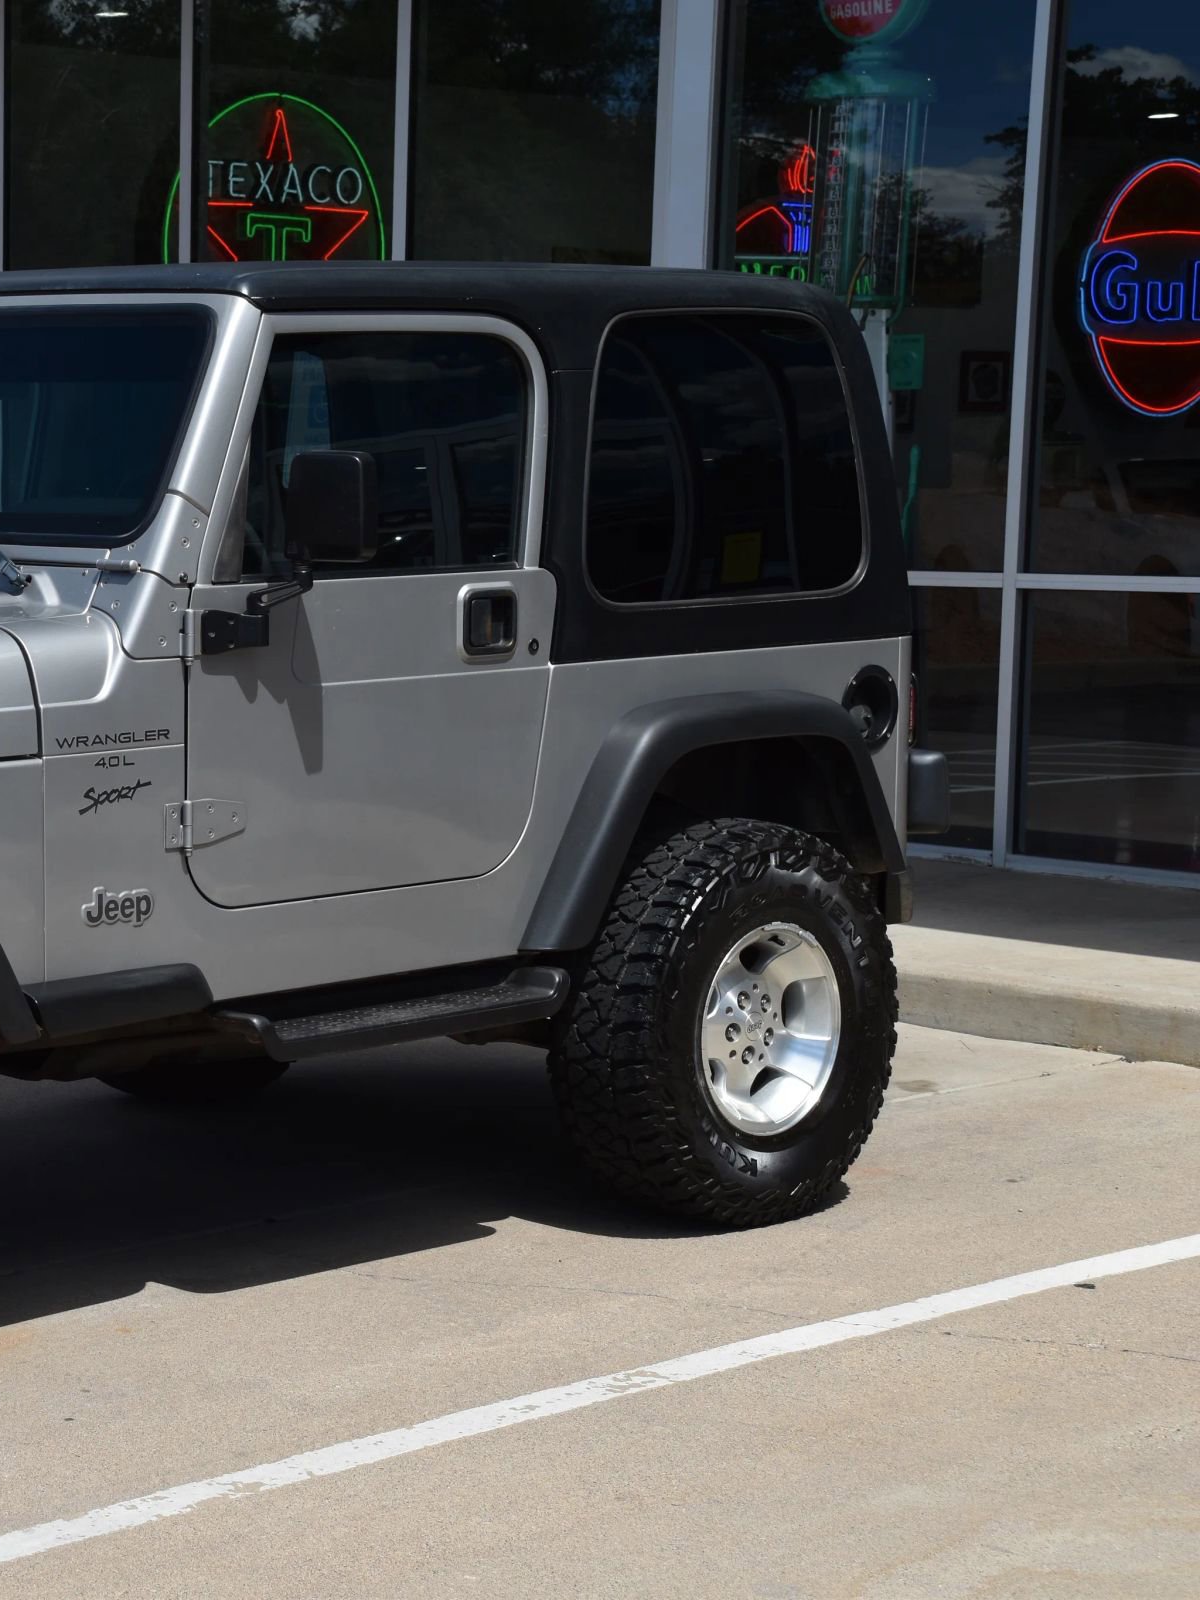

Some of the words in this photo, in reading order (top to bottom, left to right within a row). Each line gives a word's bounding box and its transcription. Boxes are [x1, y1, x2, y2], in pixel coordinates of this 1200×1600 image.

[830, 0, 894, 19] GASOLINE
[207, 160, 363, 204] TEXACO
[55, 728, 171, 749] WRANGLER
[85, 890, 152, 924] Jeep
